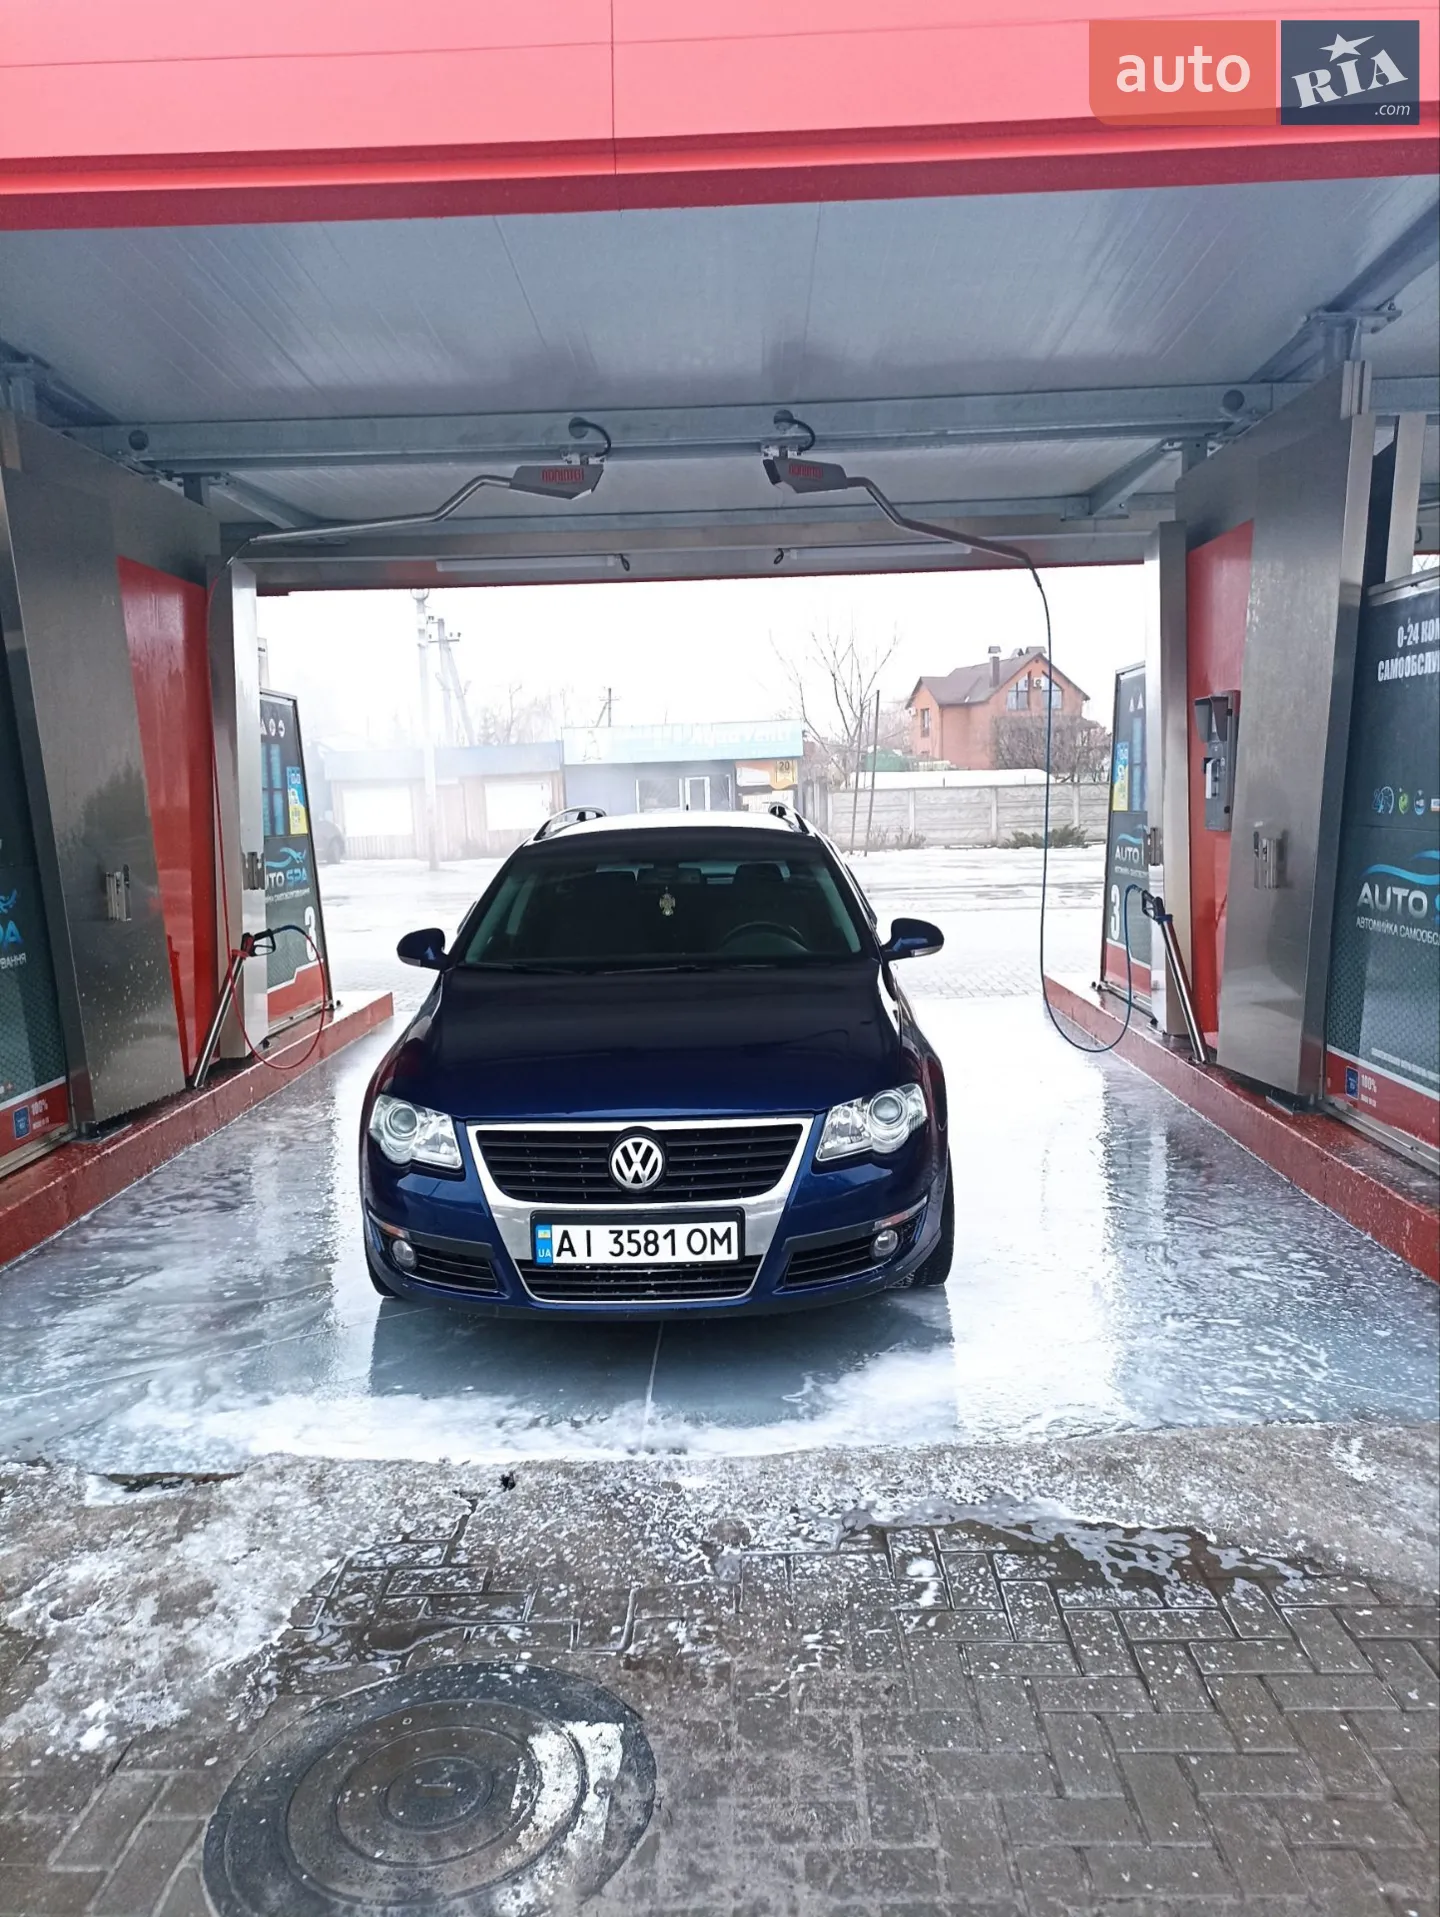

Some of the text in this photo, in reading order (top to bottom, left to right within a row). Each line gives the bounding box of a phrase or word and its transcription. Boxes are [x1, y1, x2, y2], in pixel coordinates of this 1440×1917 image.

[1397, 622, 1419, 648] 0-24
[1115, 844, 1139, 864] AUTO
[1110, 885, 1121, 941] 3
[1357, 882, 1428, 919] AUTO
[304, 906, 317, 961] 3
[1400, 925, 1440, 946] САМООБС
[538, 1248, 551, 1258] UA
[556, 1226, 733, 1258] AI 3581 OM
